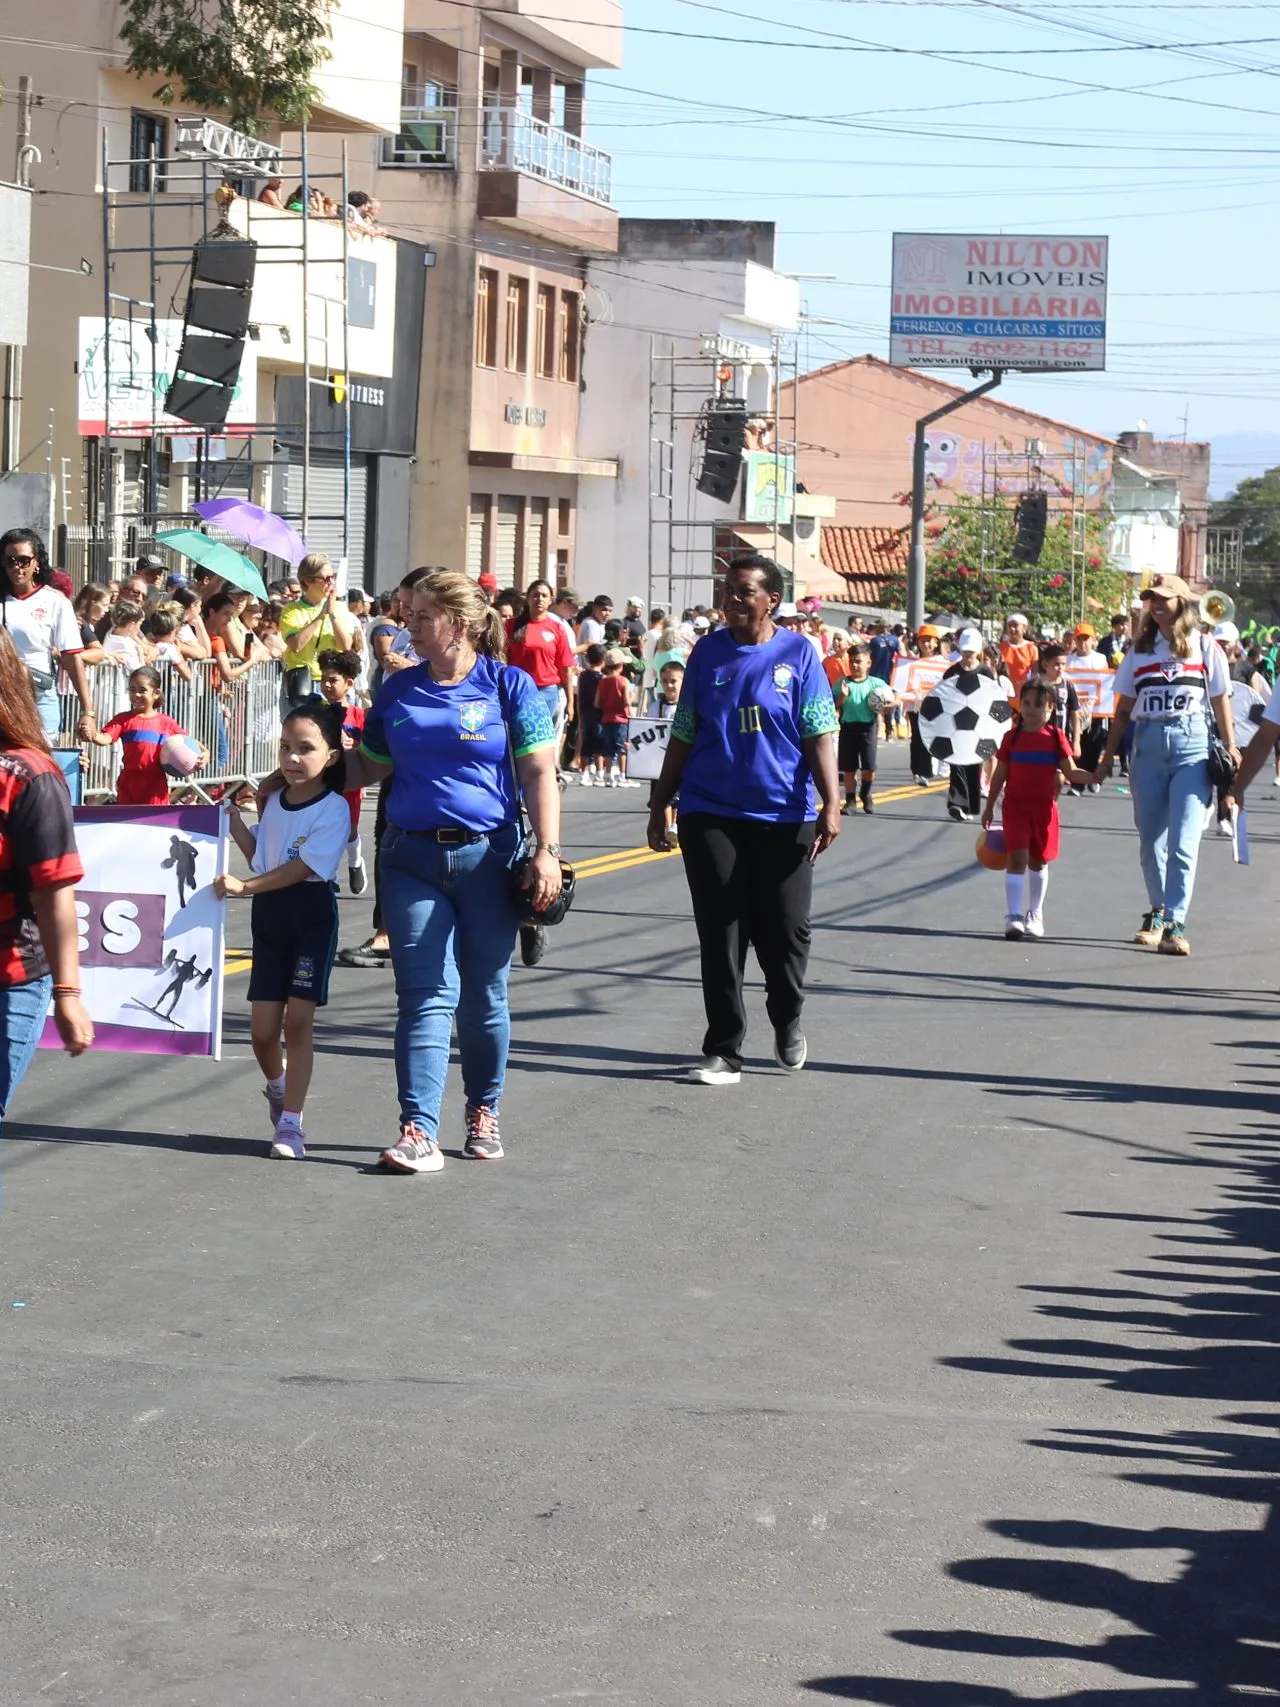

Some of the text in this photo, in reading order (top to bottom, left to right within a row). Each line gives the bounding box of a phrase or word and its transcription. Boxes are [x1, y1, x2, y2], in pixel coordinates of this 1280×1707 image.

[965, 240, 1104, 268] NILTON
[967, 268, 1105, 287] IMÓVEIS
[893, 292, 1103, 318] IMOBILIÁRIA
[894, 320, 963, 333] TERRENOS
[974, 320, 1047, 336] CHÁCARAS
[1058, 323, 1102, 336] SÍTIOS
[901, 338, 1093, 358] TEL. 4692-1162
[908, 356, 1086, 367] www.niltonimoveis.com
[1143, 690, 1194, 712] inter
[739, 705, 762, 733] 10
